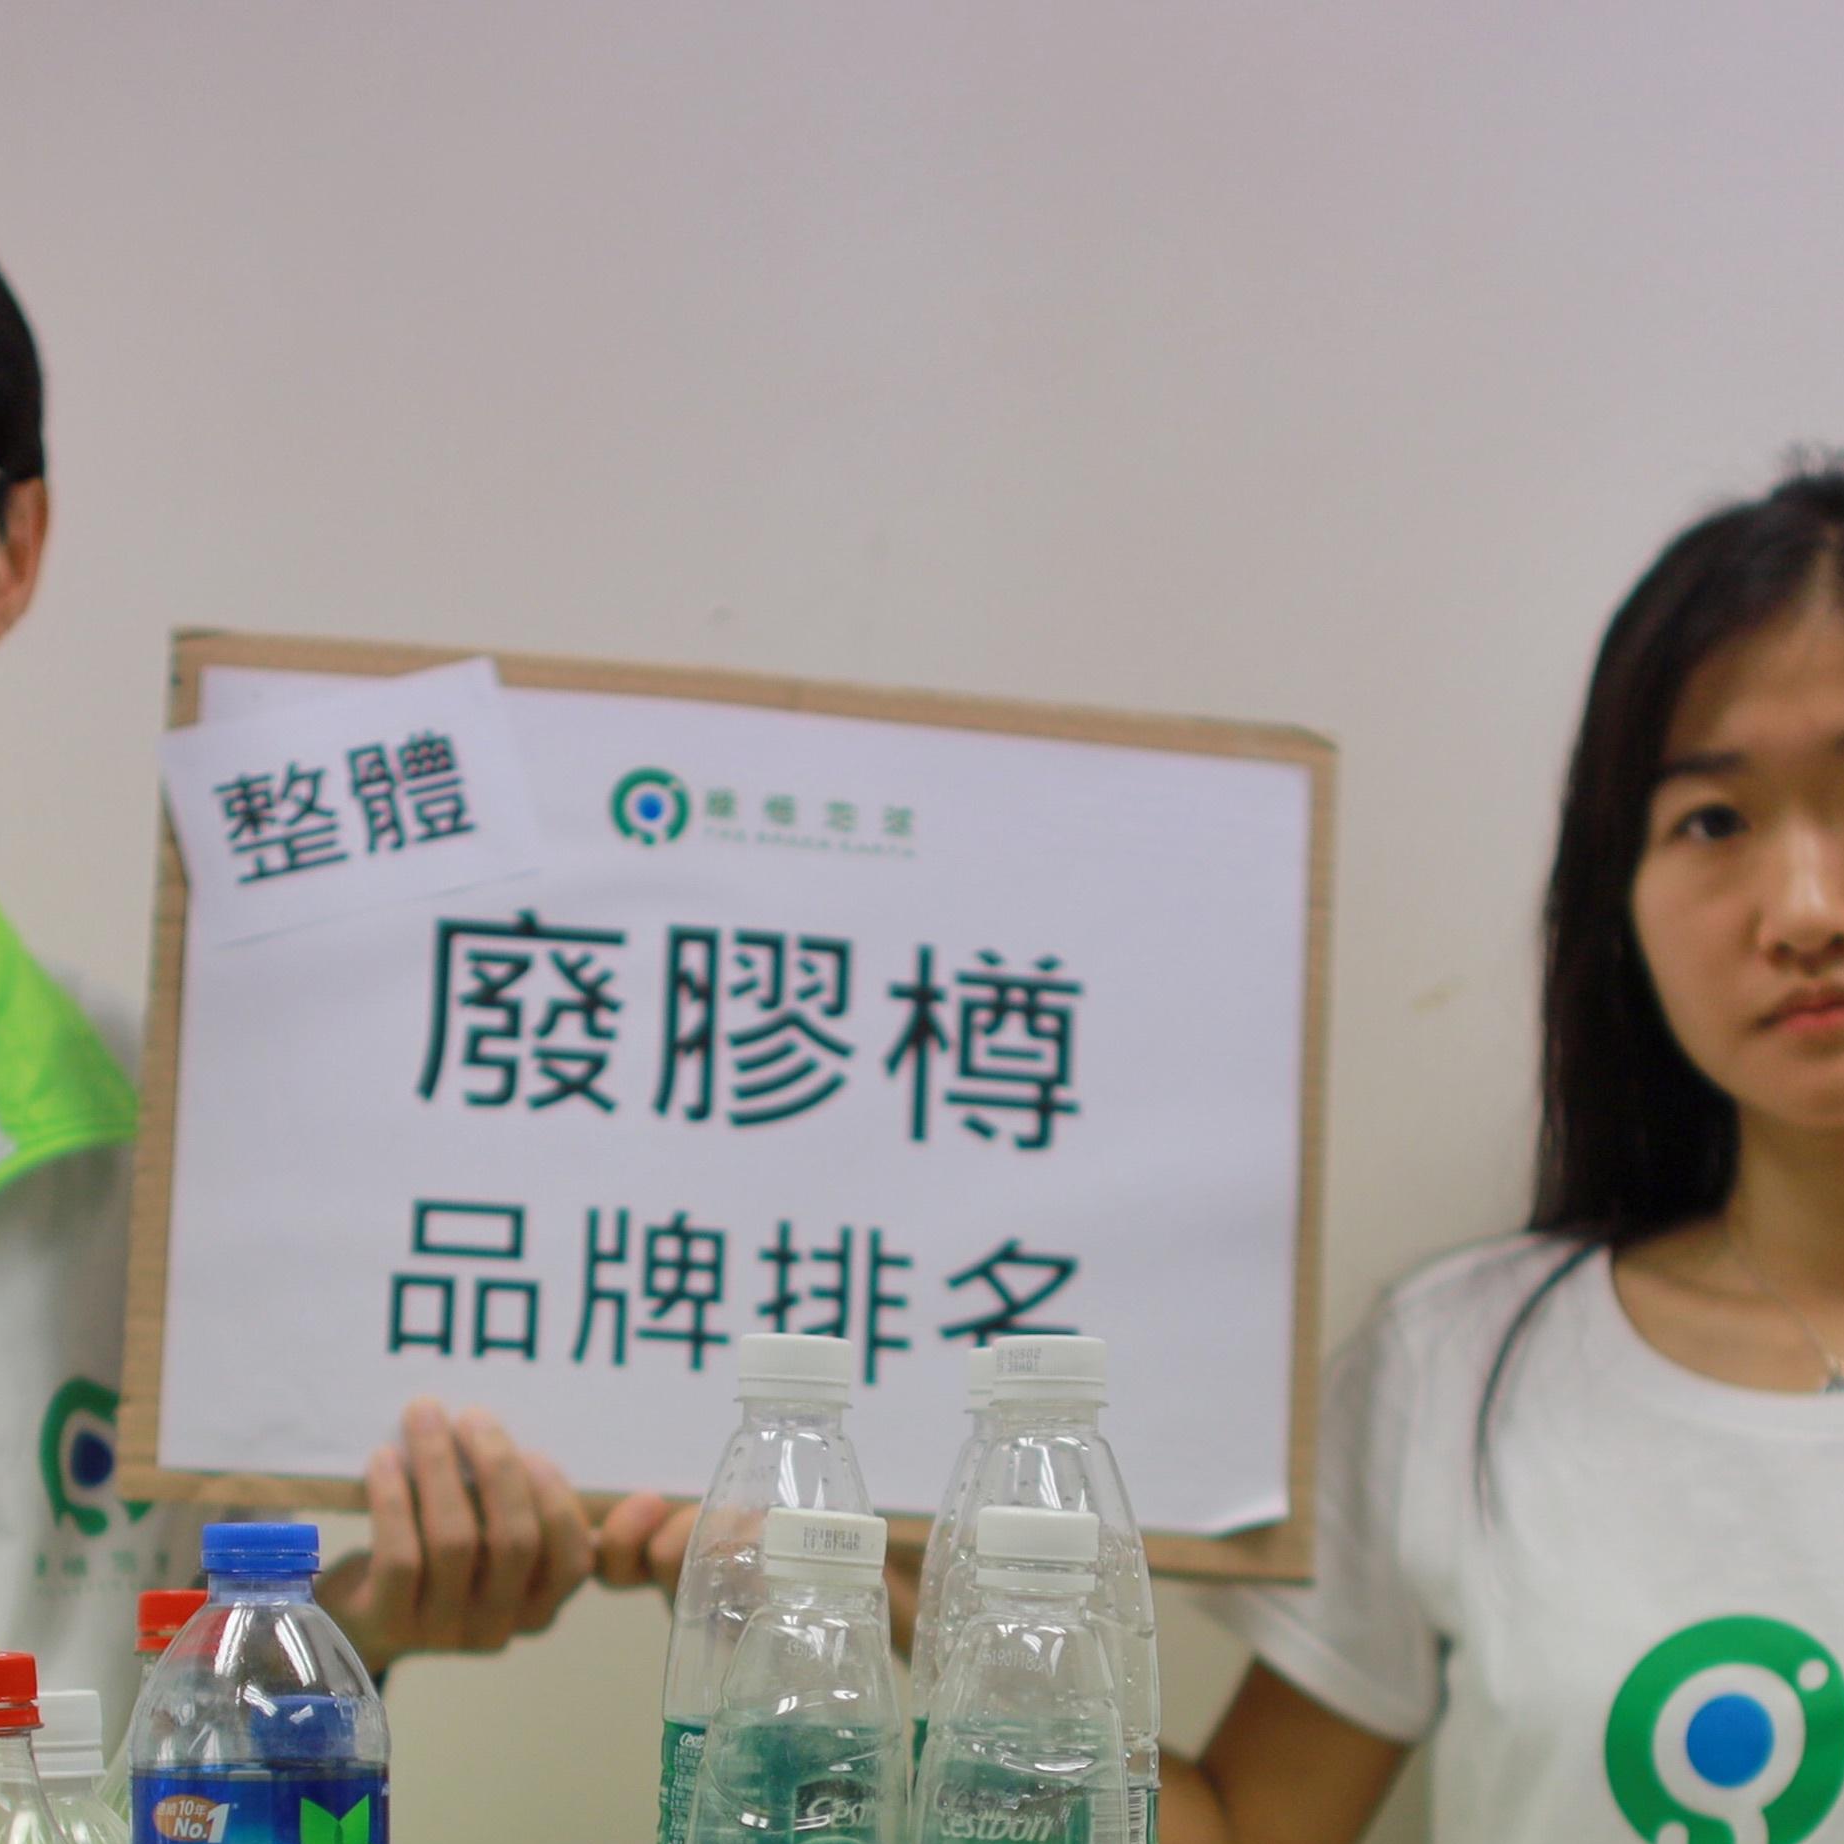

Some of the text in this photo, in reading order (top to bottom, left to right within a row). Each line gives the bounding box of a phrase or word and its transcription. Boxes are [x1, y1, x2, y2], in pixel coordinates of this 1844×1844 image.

[212, 729, 476, 885] 整體
[415, 908, 1084, 1150] 廢膠樽
[173, 1803, 231, 1844] No.1
